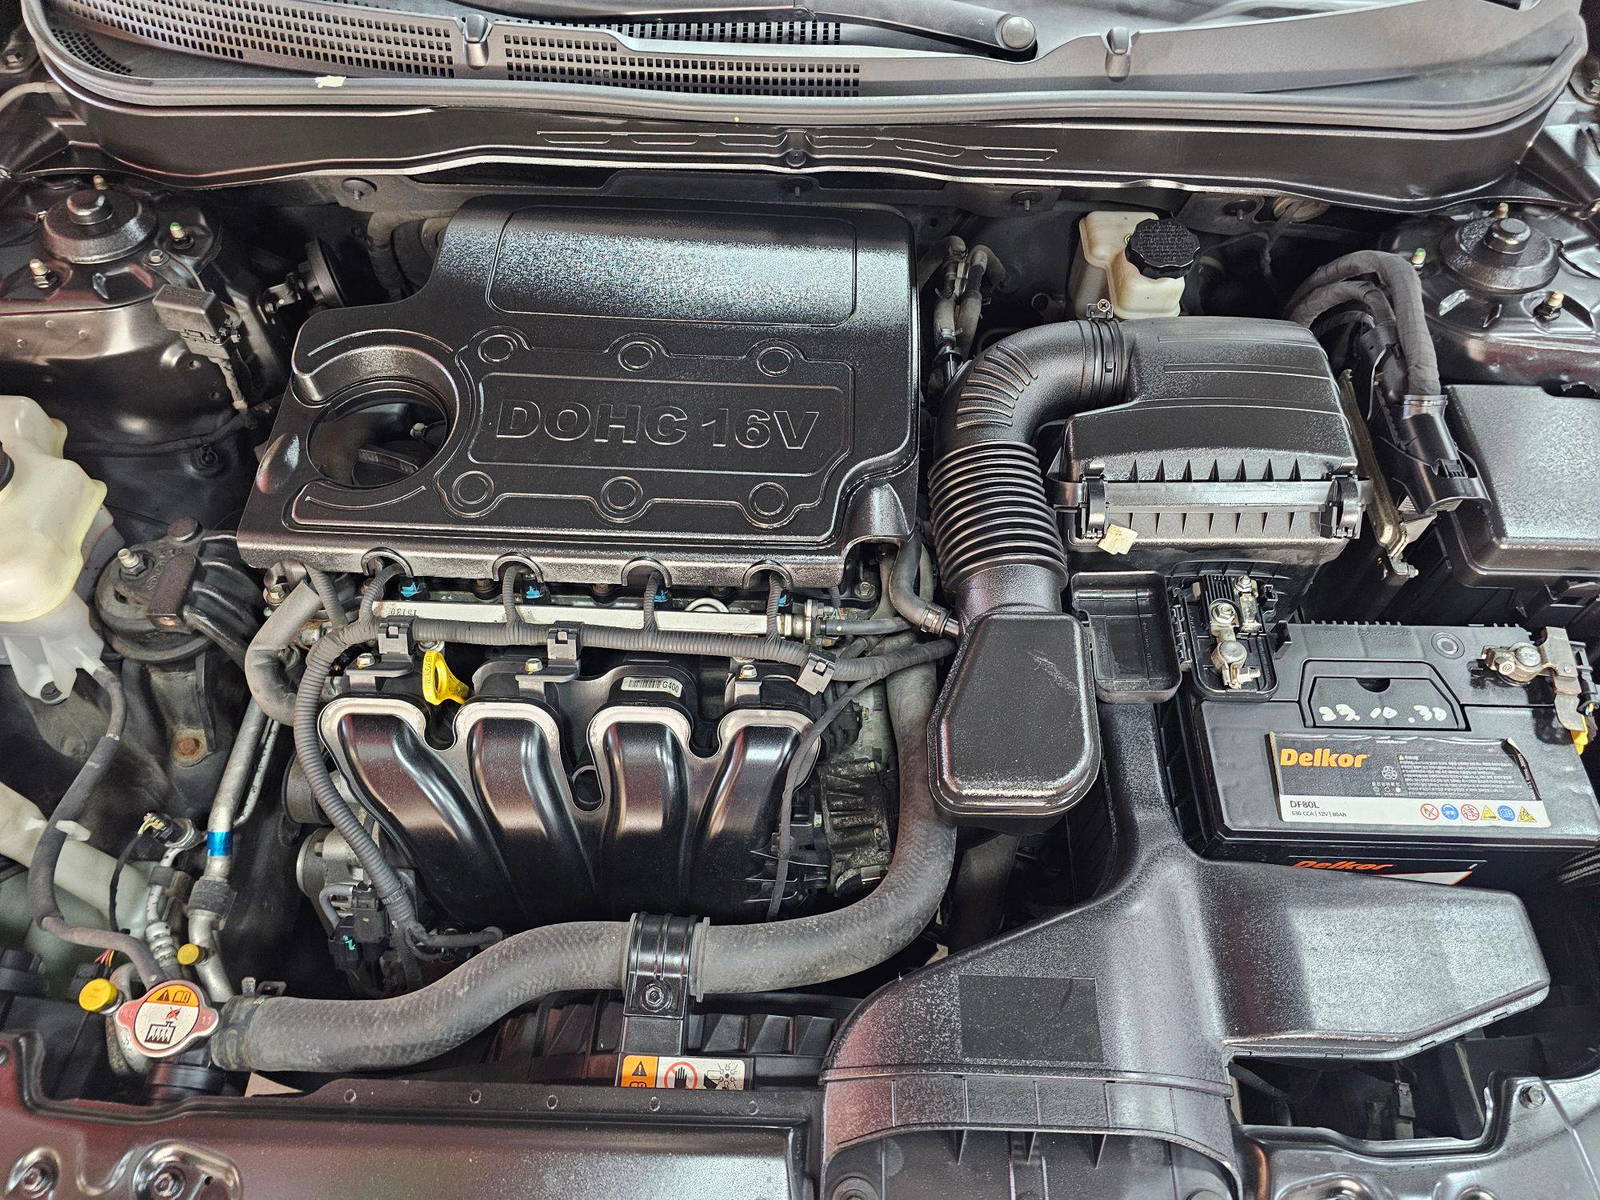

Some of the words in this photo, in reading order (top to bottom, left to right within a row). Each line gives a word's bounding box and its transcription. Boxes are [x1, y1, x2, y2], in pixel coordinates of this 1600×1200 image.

[495, 400, 688, 446] DOHC
[701, 408, 820, 450] 16V
[1279, 748, 1368, 768] Delkor
[1289, 800, 1320, 808] DF80L
[1290, 859, 1396, 871] Delkor
